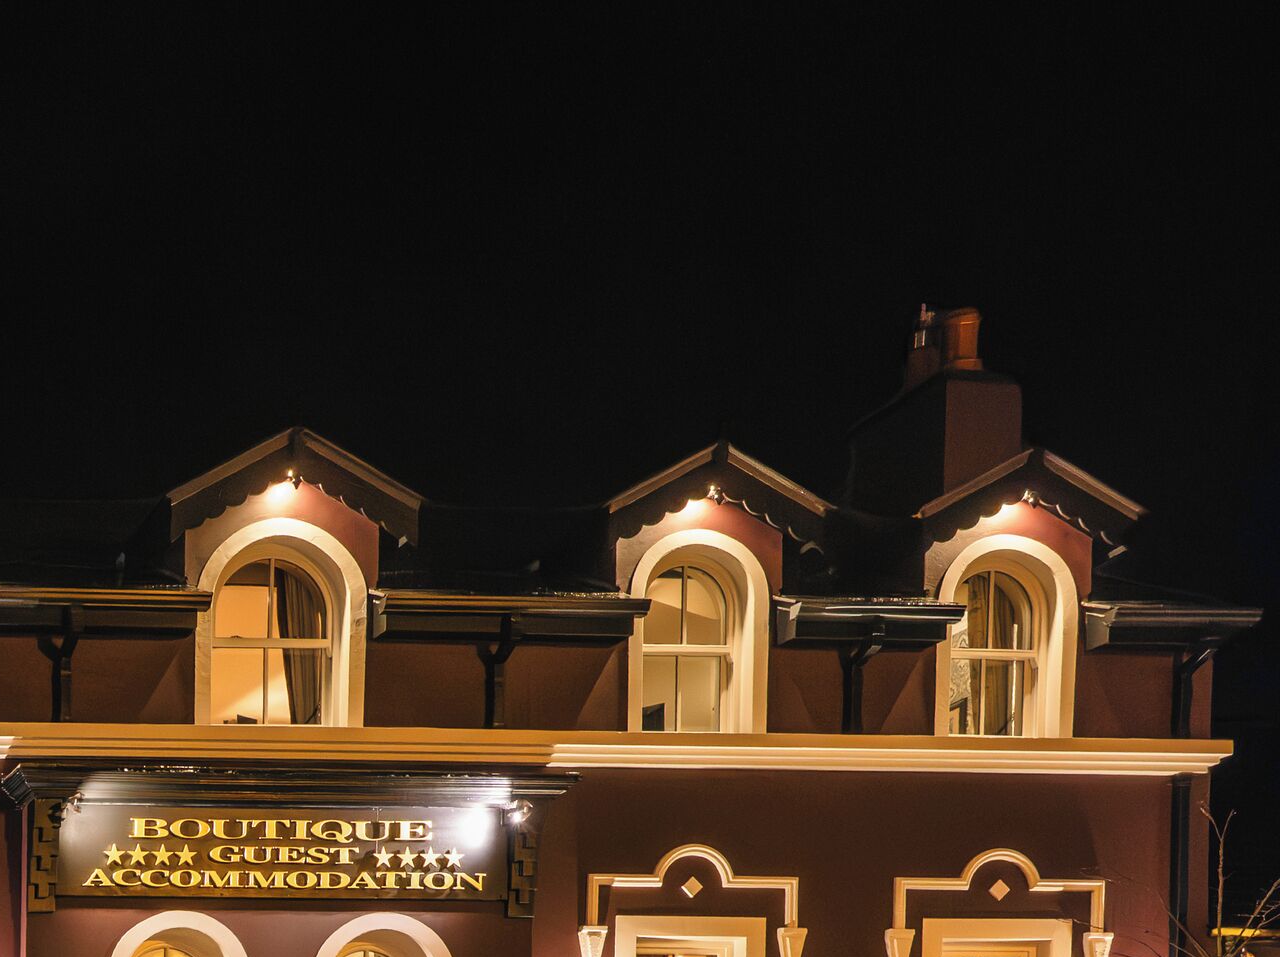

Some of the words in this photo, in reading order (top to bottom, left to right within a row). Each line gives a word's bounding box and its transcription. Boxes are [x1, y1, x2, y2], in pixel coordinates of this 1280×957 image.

[128, 818, 433, 842] BOUTIQUE
[209, 846, 360, 864] GUEST
[82, 869, 486, 891] ACCOMMODATION
